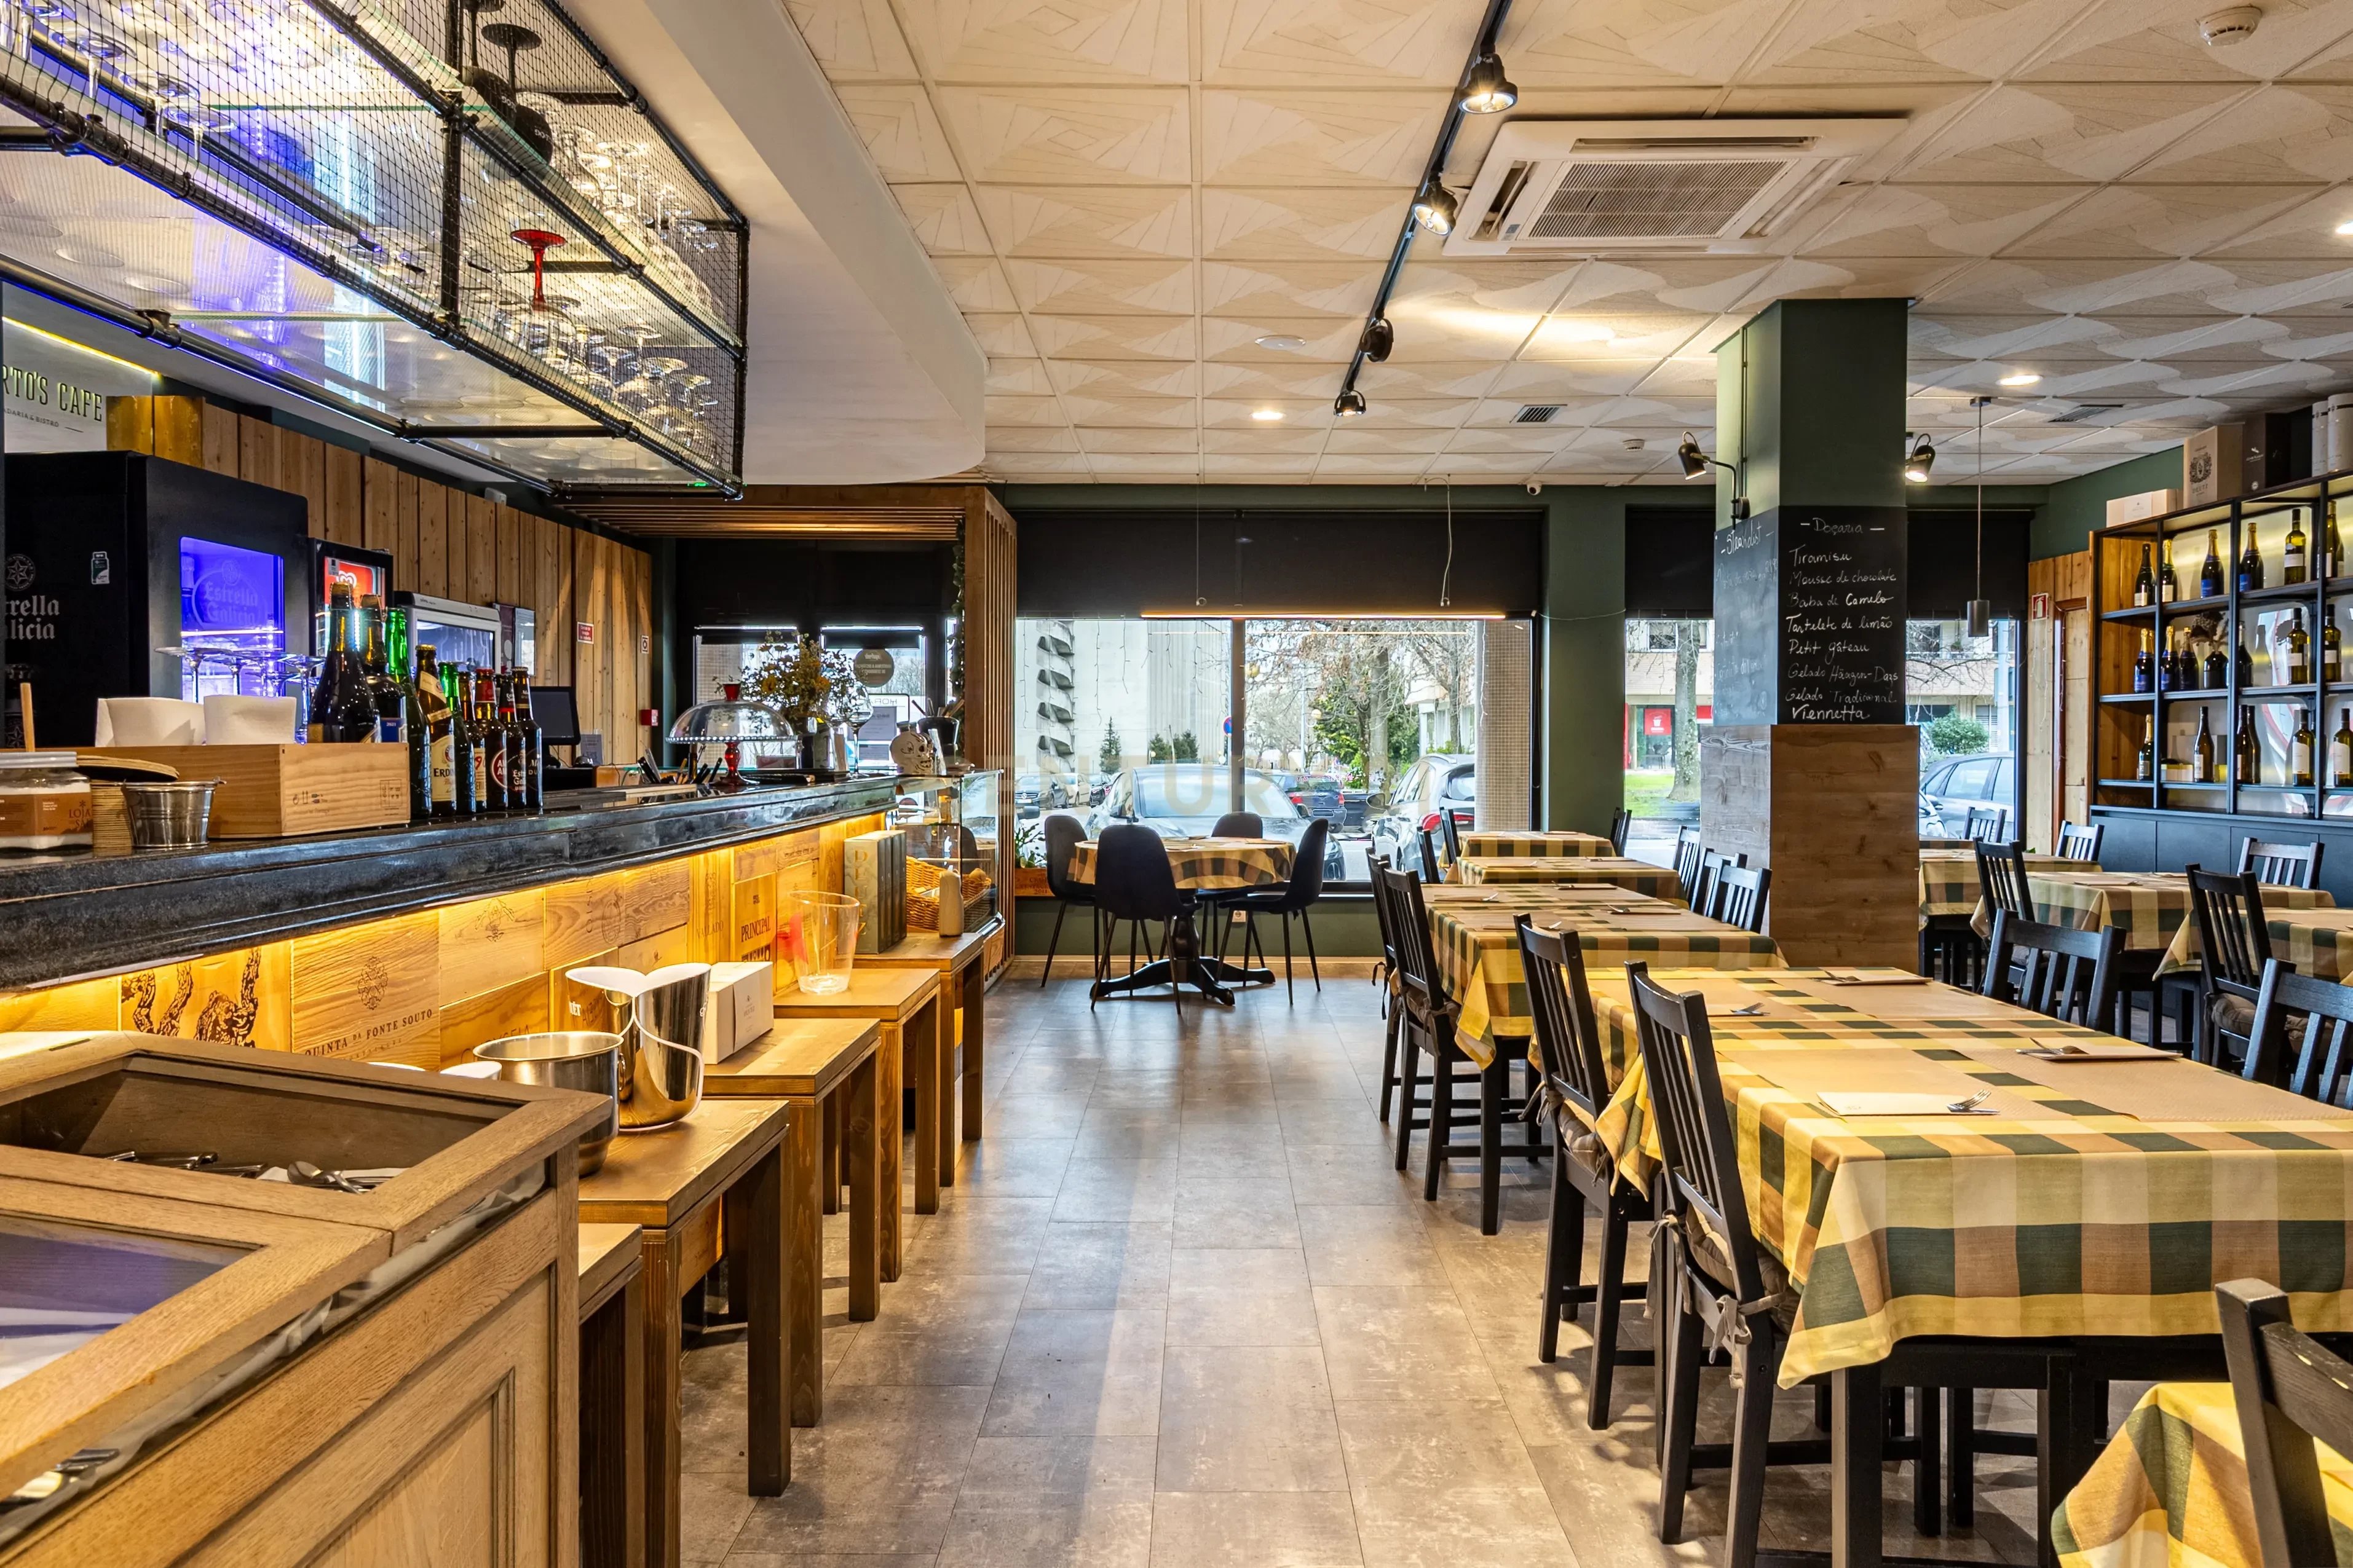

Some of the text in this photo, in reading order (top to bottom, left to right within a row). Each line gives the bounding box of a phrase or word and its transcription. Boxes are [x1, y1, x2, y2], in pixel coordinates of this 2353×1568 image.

[35, 416, 60, 428] BISTRO
[1813, 518, 1863, 535] Doçaria
[1789, 544, 1852, 567] Tiramisu
[1790, 567, 1897, 587] Mousse de chocolate
[1787, 590, 1894, 608] Baba de Camelo
[1786, 613, 1892, 633] Tartelete de limão
[1788, 639, 1870, 665] Petit gâteau
[1788, 663, 1825, 679] Gelado
[1785, 687, 1897, 704] Gelado Tradicional
[1792, 704, 1870, 722] Viennetta
[696, 920, 724, 939] VALLADO
[741, 916, 771, 942] PRINCIPAL
[366, 1020, 398, 1040] FONTE
[403, 1009, 432, 1028] SOUTO
